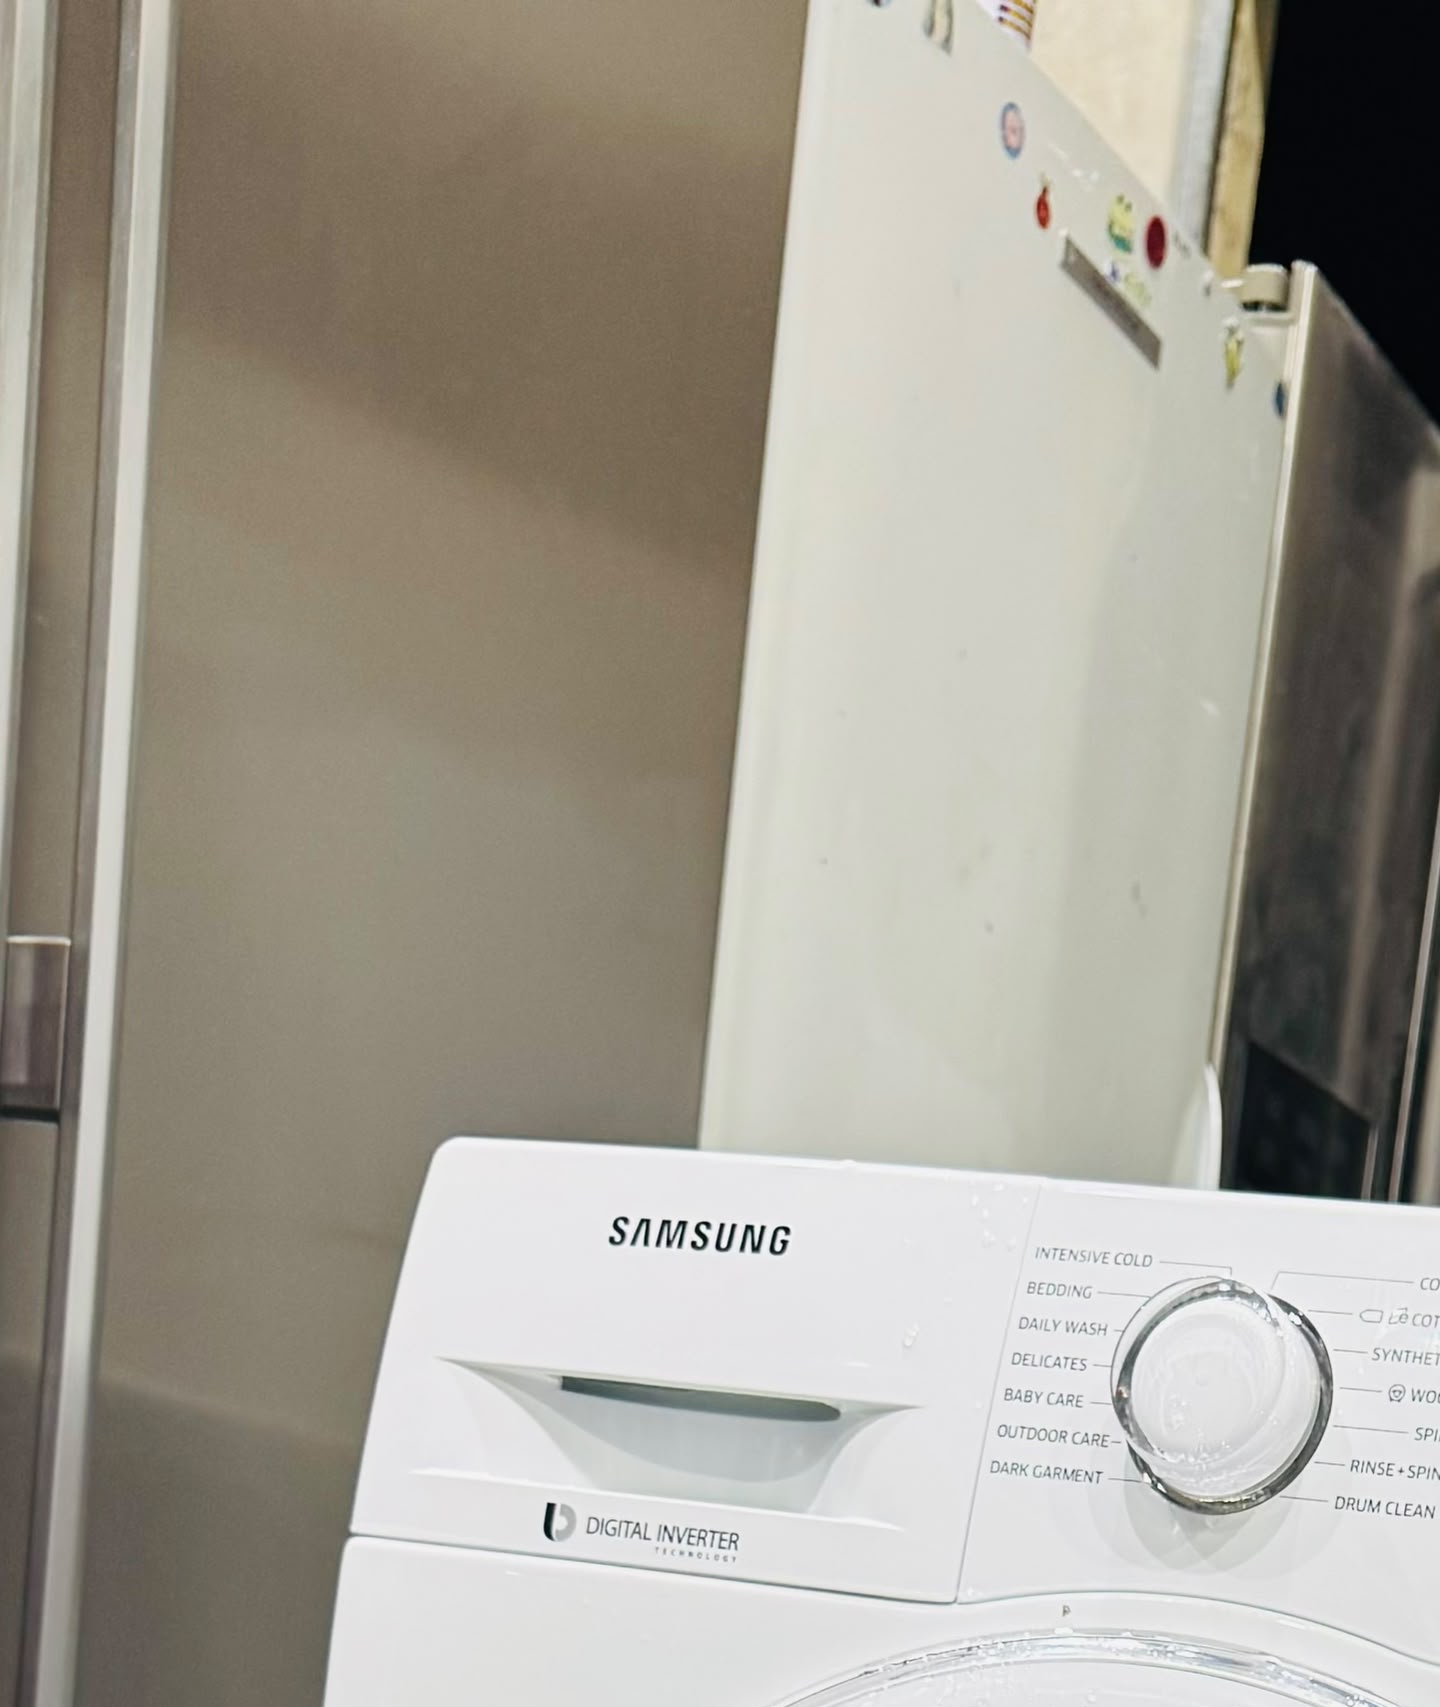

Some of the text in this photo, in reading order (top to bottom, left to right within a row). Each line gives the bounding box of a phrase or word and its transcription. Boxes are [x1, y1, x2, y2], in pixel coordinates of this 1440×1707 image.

[608, 1215, 792, 1256] SAMSUNG
[1035, 1247, 1153, 1268] INTENSIVE COLD
[1027, 1281, 1092, 1299] BEDDING
[1018, 1316, 1108, 1336] DAILY WASH
[1011, 1352, 1088, 1371] DELICATES
[1004, 1388, 1084, 1408] BABY CARE
[997, 1424, 1110, 1448] OUTDOOR CARE
[990, 1460, 1104, 1484] DARK GARMENT
[1350, 1459, 1395, 1477] RINSE
[1335, 1496, 1436, 1519] DRUM CLEAN
[586, 1516, 740, 1551] DIGITAL INVERTER
